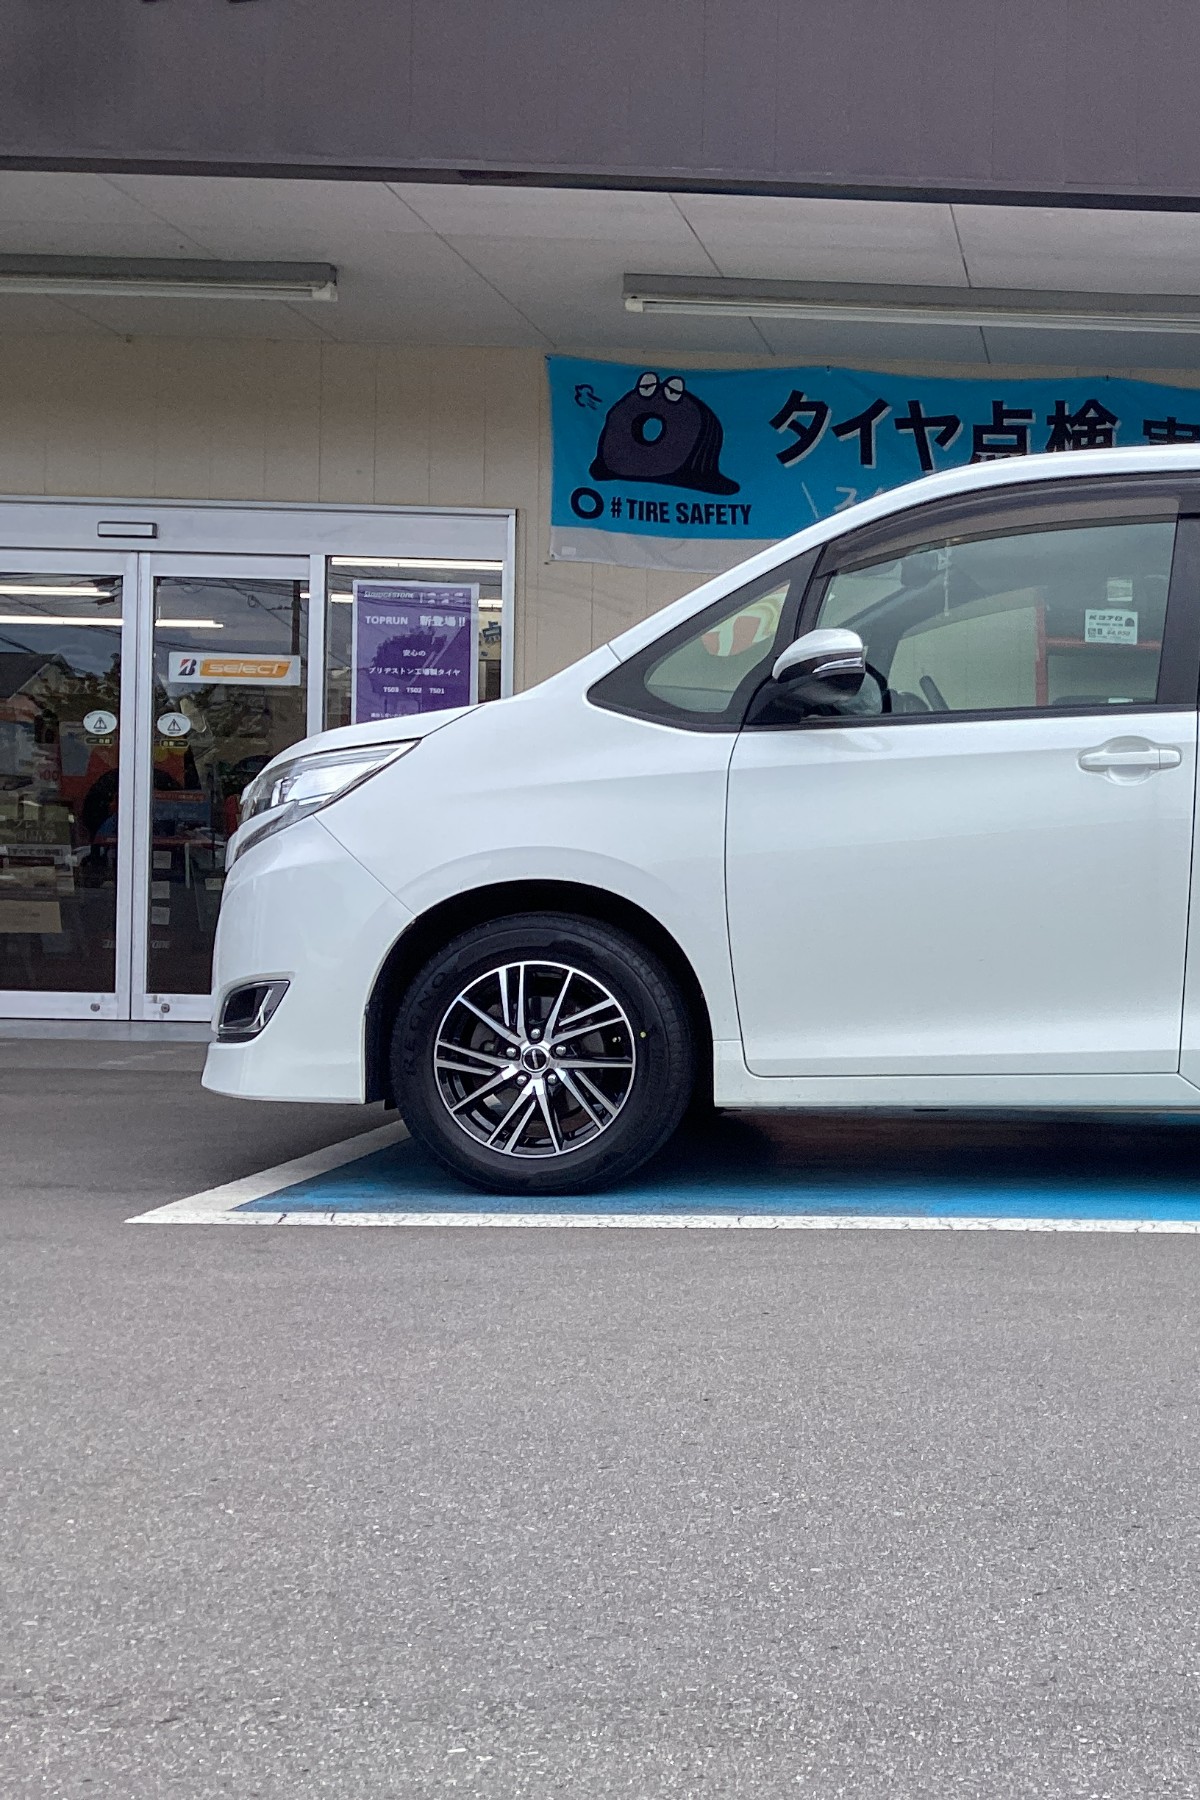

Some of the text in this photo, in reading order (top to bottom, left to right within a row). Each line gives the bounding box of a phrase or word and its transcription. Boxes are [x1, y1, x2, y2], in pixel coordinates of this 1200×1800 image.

[675, 502, 752, 525] SAFETY
[365, 615, 408, 625] TOPRUN
[402, 649, 426, 657] 安心の
[208, 662, 284, 675] select
